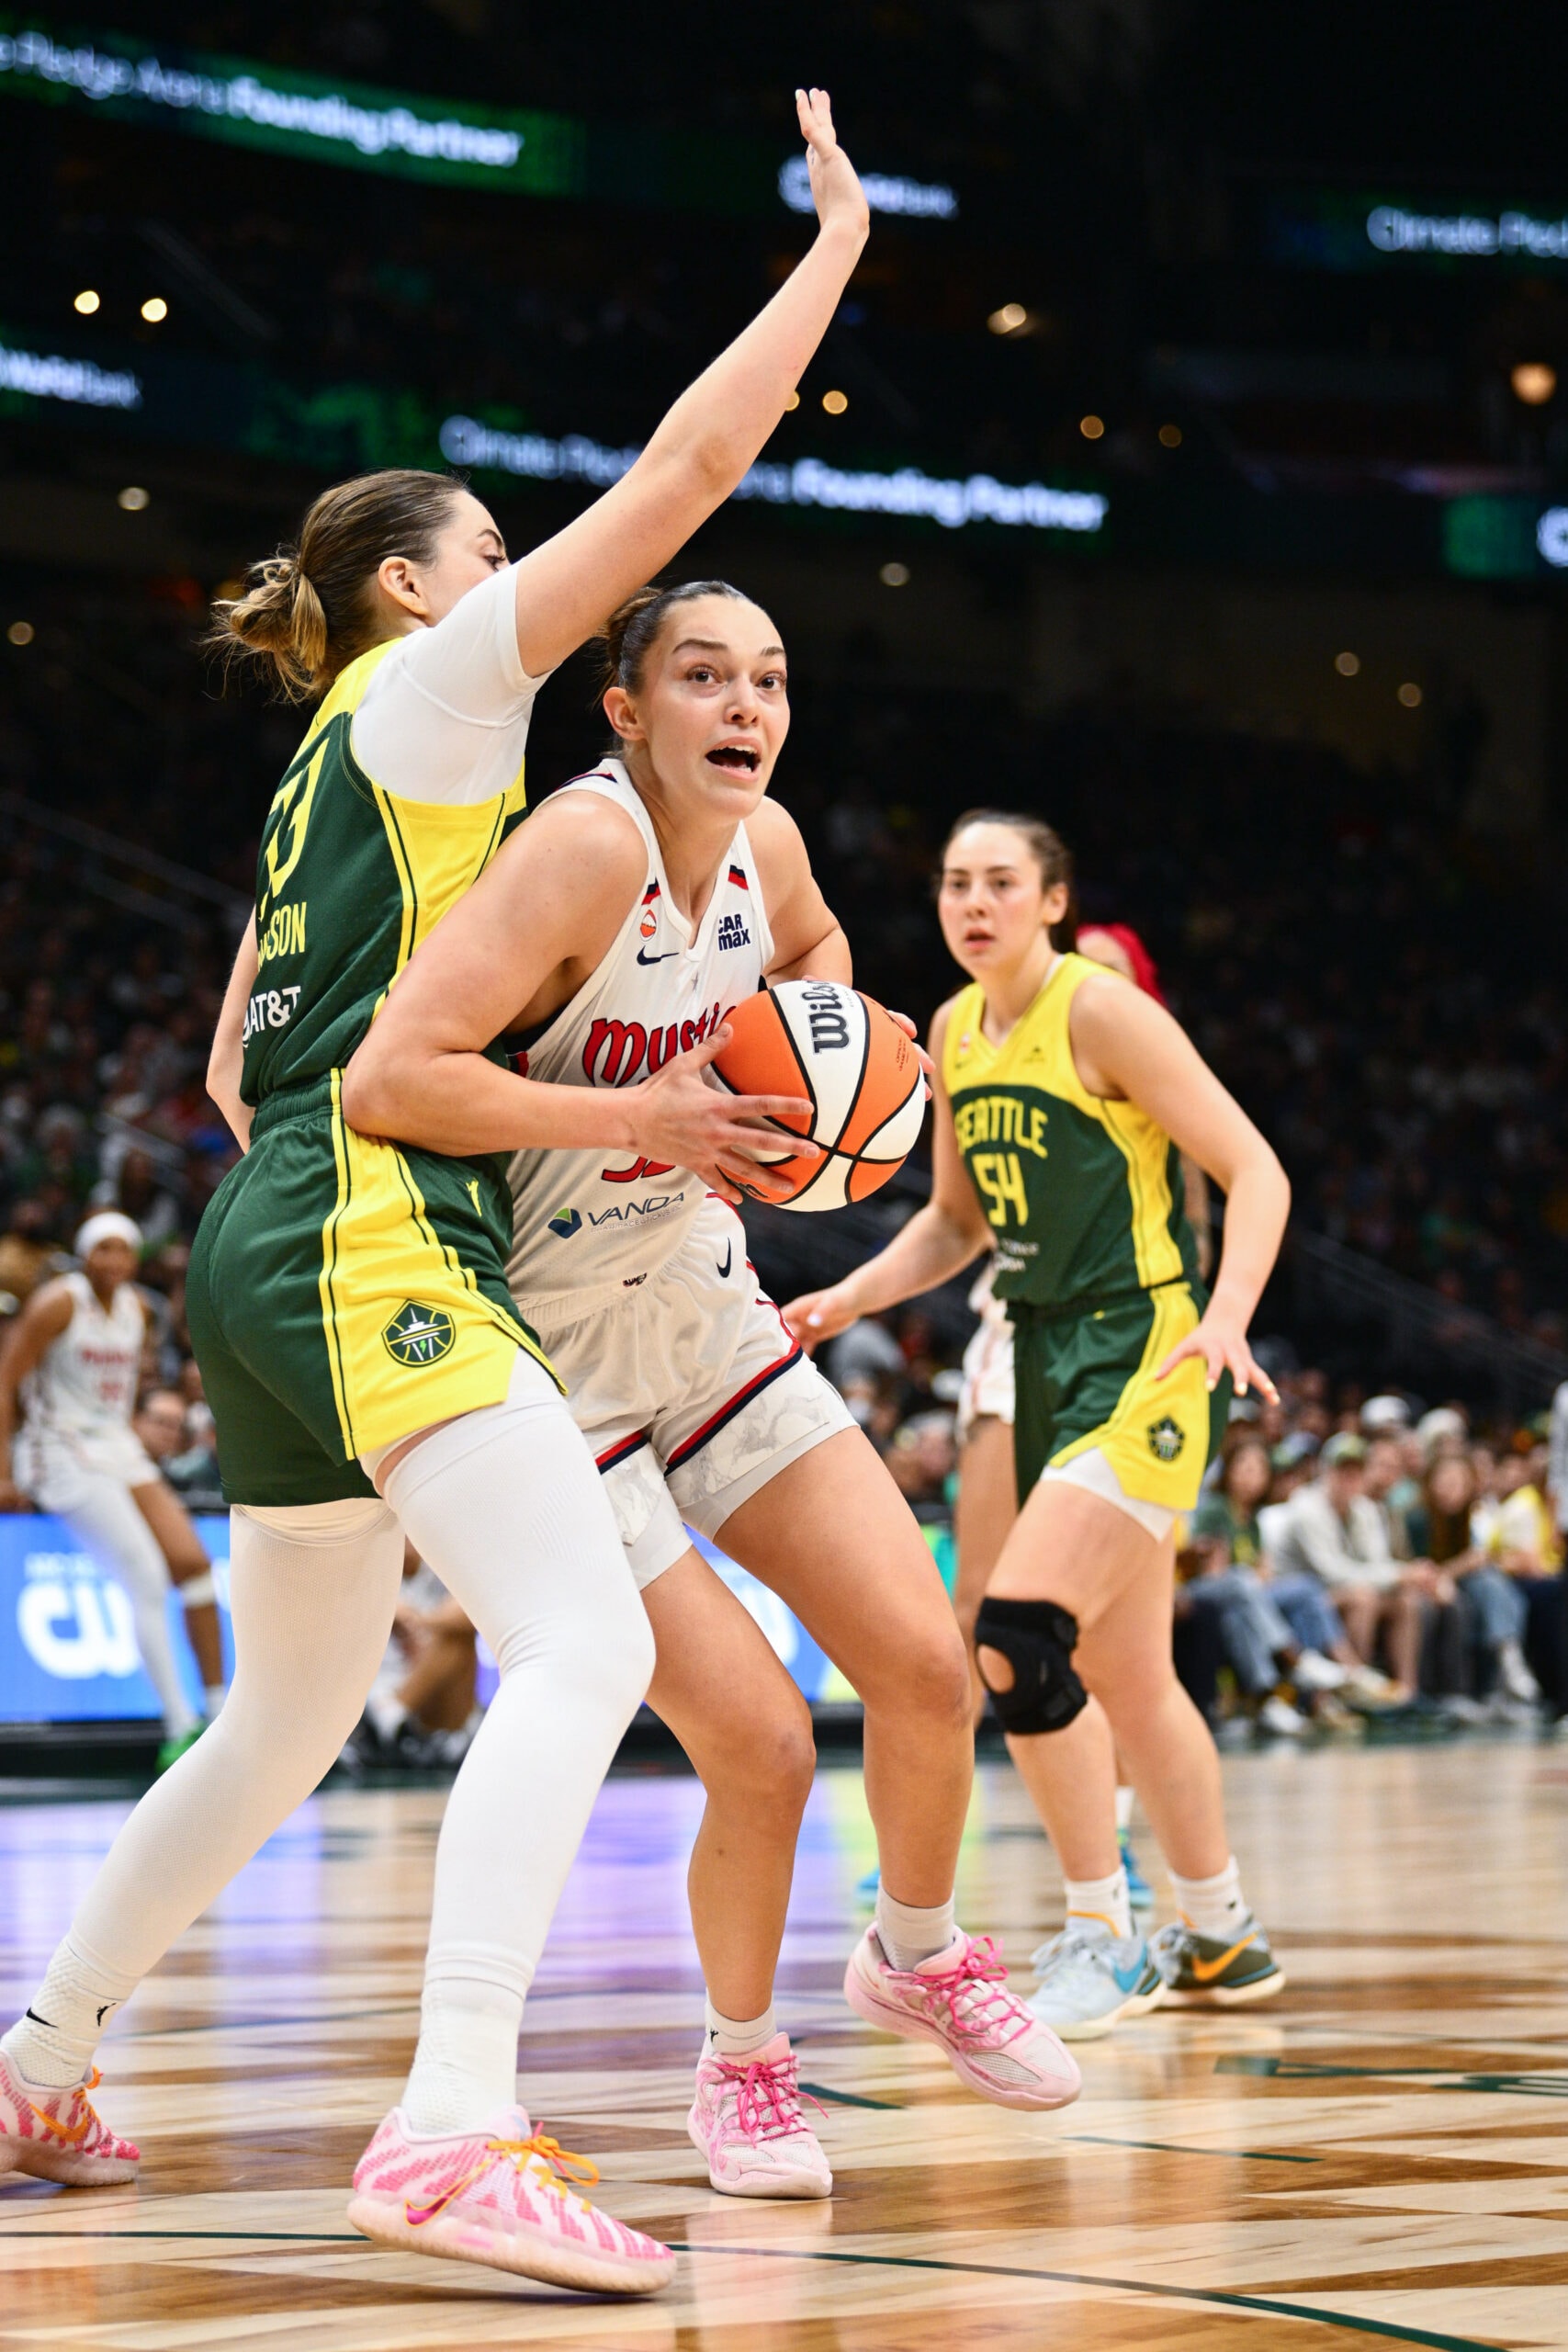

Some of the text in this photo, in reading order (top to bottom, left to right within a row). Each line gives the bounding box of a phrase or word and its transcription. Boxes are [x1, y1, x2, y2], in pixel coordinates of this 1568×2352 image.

[229, 75, 389, 155] Founding
[387, 107, 525, 168] Partner
[792, 457, 968, 529] Founding
[964, 472, 1110, 533] Partner
[718, 929, 750, 952] max
[249, 985, 302, 1036] AT&T
[587, 1192, 684, 1227] VANDA
[971, 1152, 1029, 1227] 54
